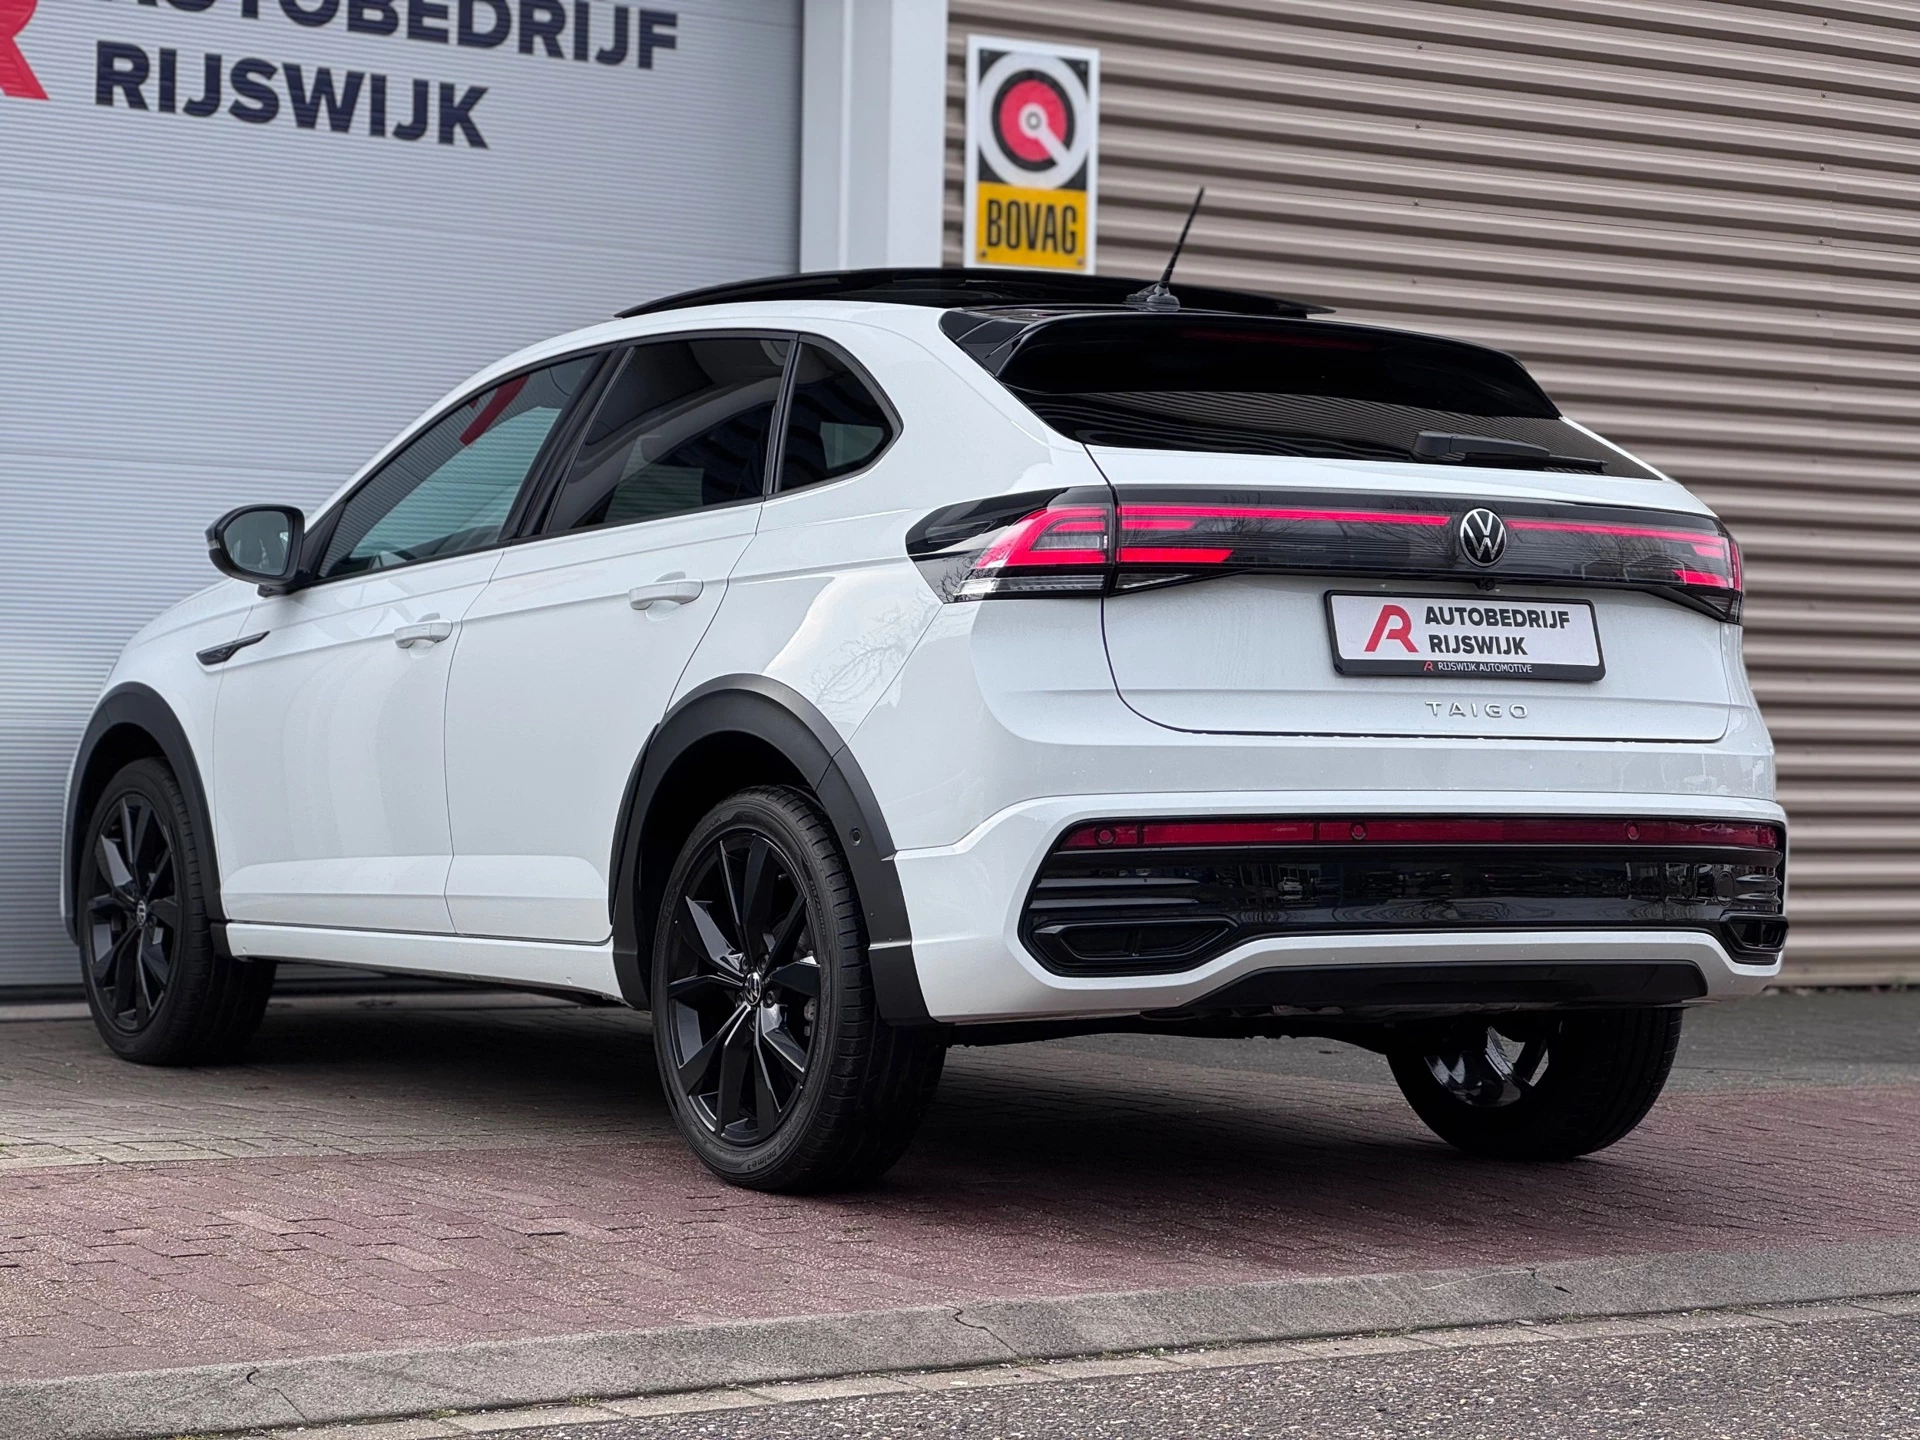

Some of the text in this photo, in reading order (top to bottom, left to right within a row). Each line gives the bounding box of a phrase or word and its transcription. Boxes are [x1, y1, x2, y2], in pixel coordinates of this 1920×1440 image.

[95, 39, 490, 150] RIJSWIJK
[986, 198, 1078, 255] BOVAG
[1425, 606, 1570, 629] AUTOBEDRIJF
[1428, 634, 1529, 656] RIJSWIJK
[1437, 661, 1478, 672] RIJSWIJK
[1479, 663, 1533, 673] AUTOMOTIVE
[1425, 701, 1529, 719] TAIGO
